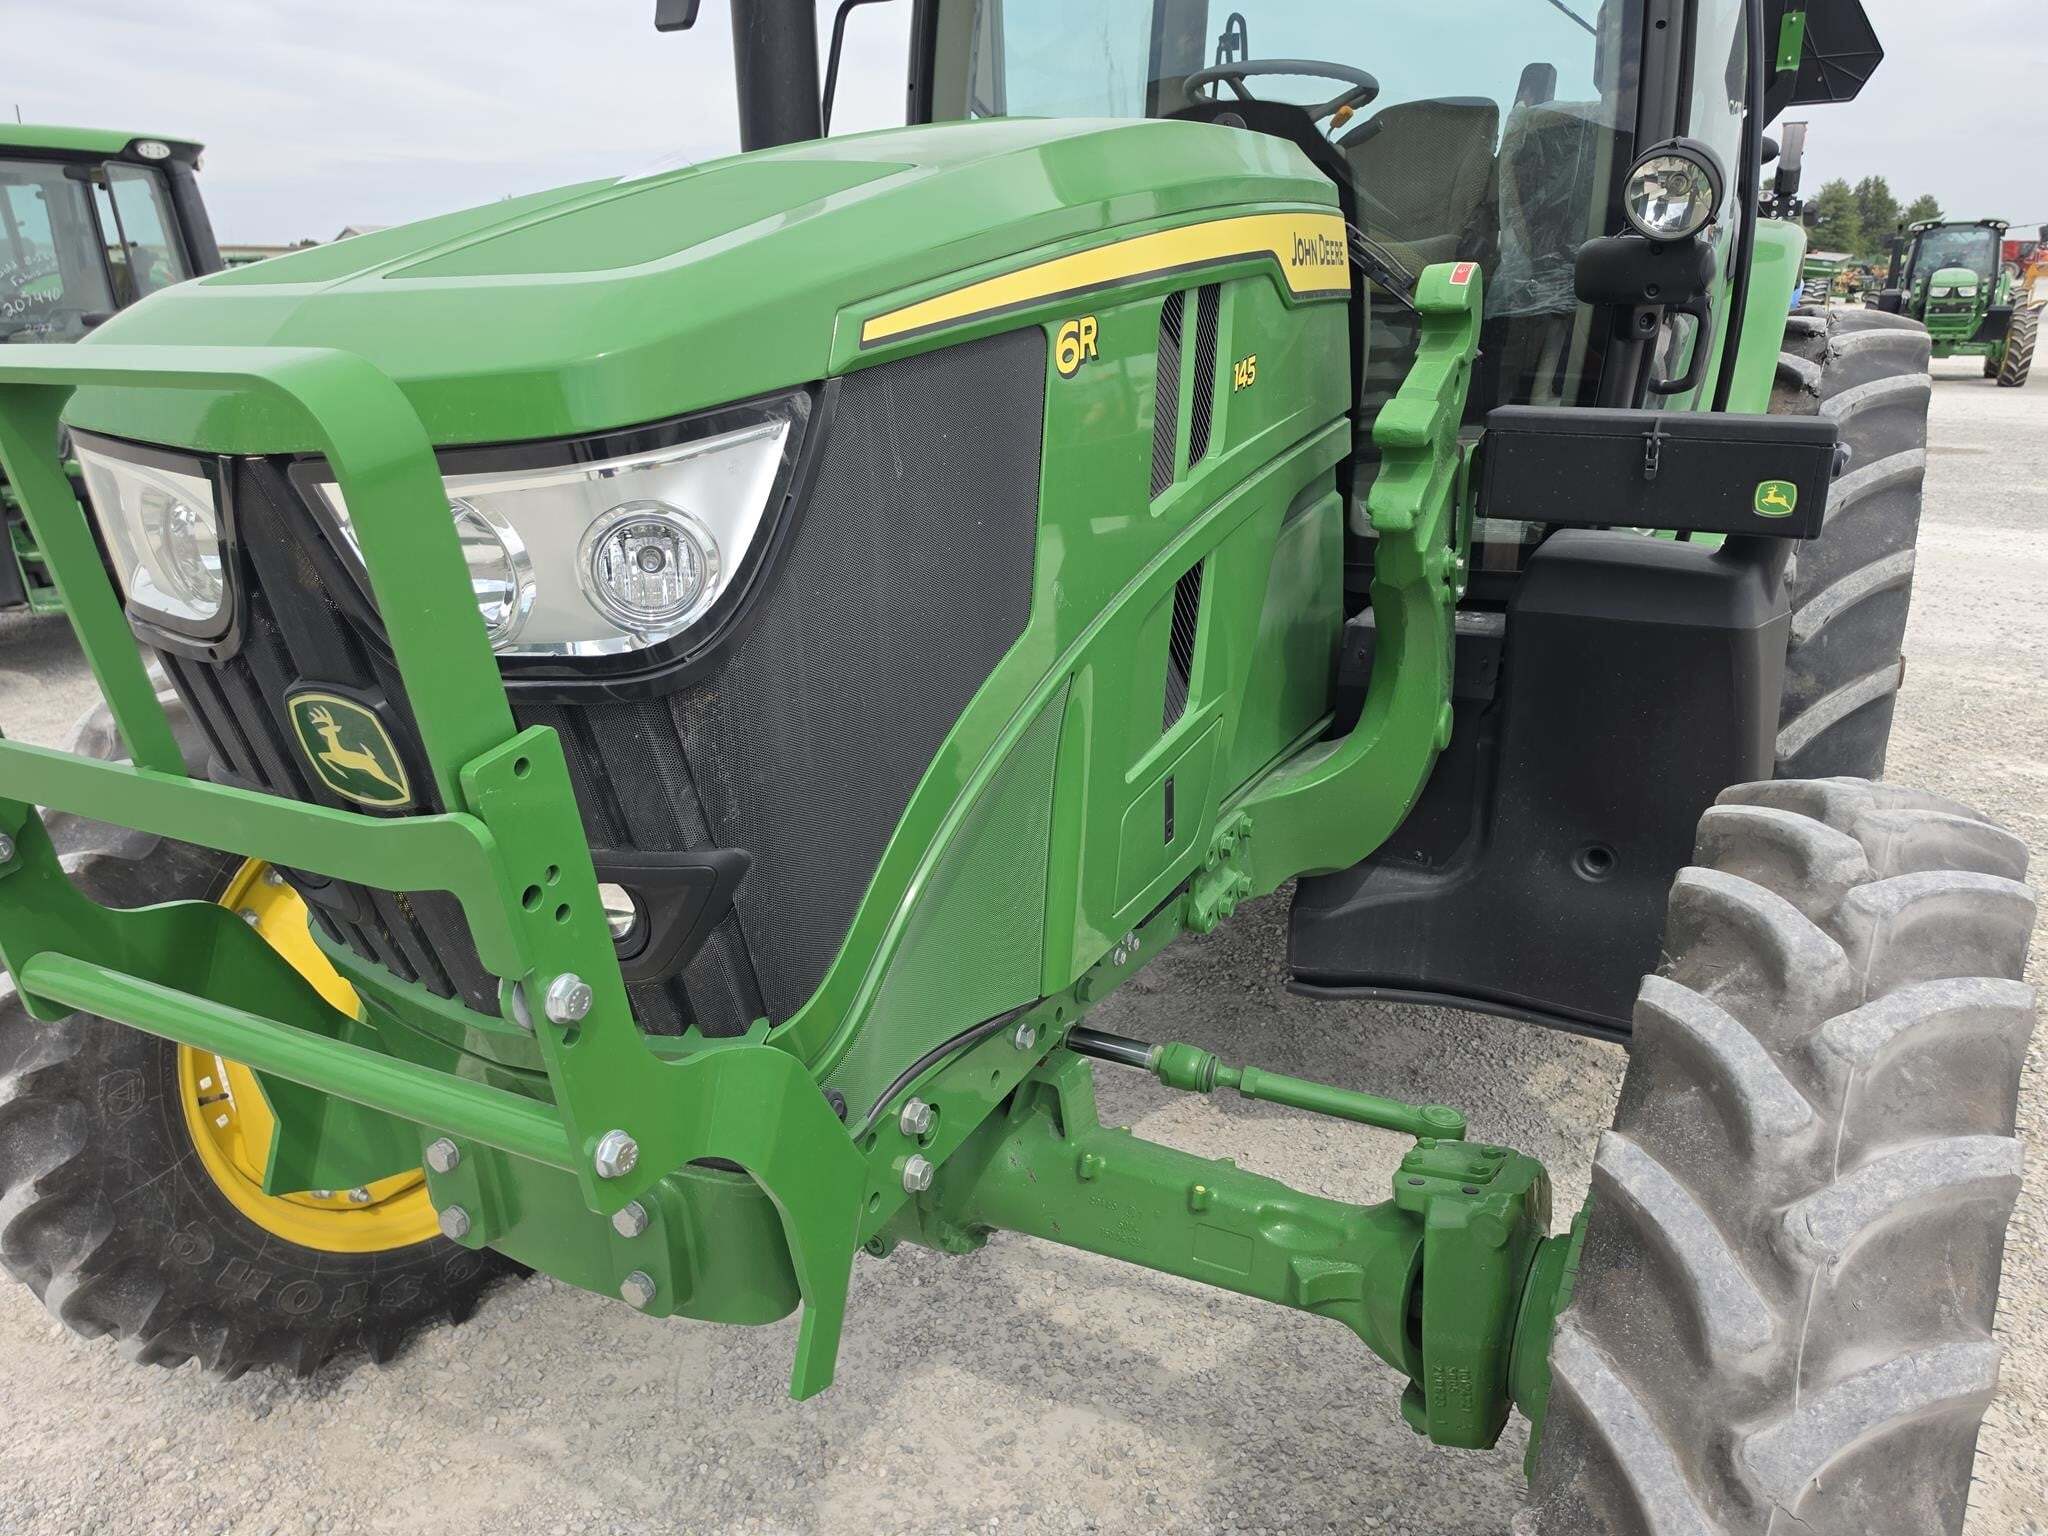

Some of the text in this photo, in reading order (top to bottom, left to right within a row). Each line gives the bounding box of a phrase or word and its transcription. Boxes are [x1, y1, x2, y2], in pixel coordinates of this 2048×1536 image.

[1291, 232, 1344, 266] JOHN DEERE
[1056, 314, 1100, 379] 6R
[1234, 353, 1257, 393] 145
